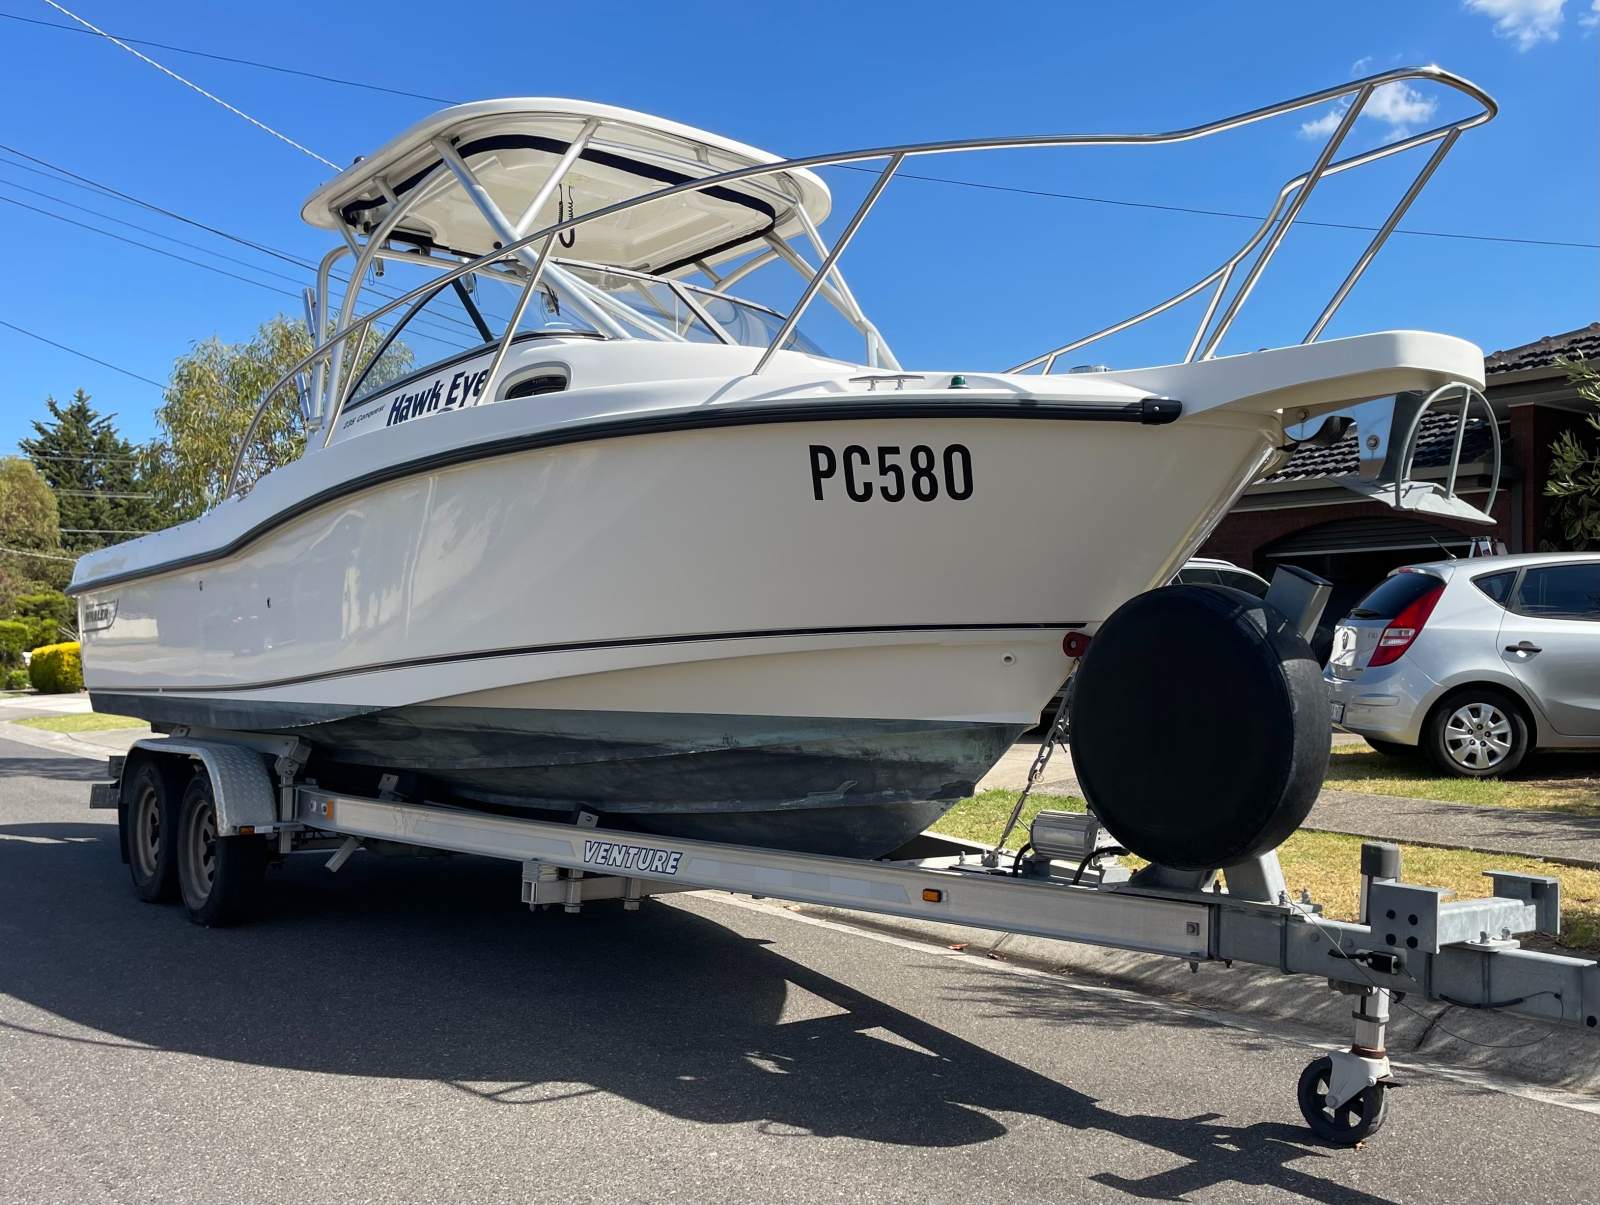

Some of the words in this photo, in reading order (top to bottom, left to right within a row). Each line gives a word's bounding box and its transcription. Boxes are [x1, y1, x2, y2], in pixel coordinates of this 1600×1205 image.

[386, 379, 445, 427] Hawk
[445, 368, 490, 408] Eye
[809, 443, 974, 503] PC580
[583, 840, 683, 875] VENTURE
